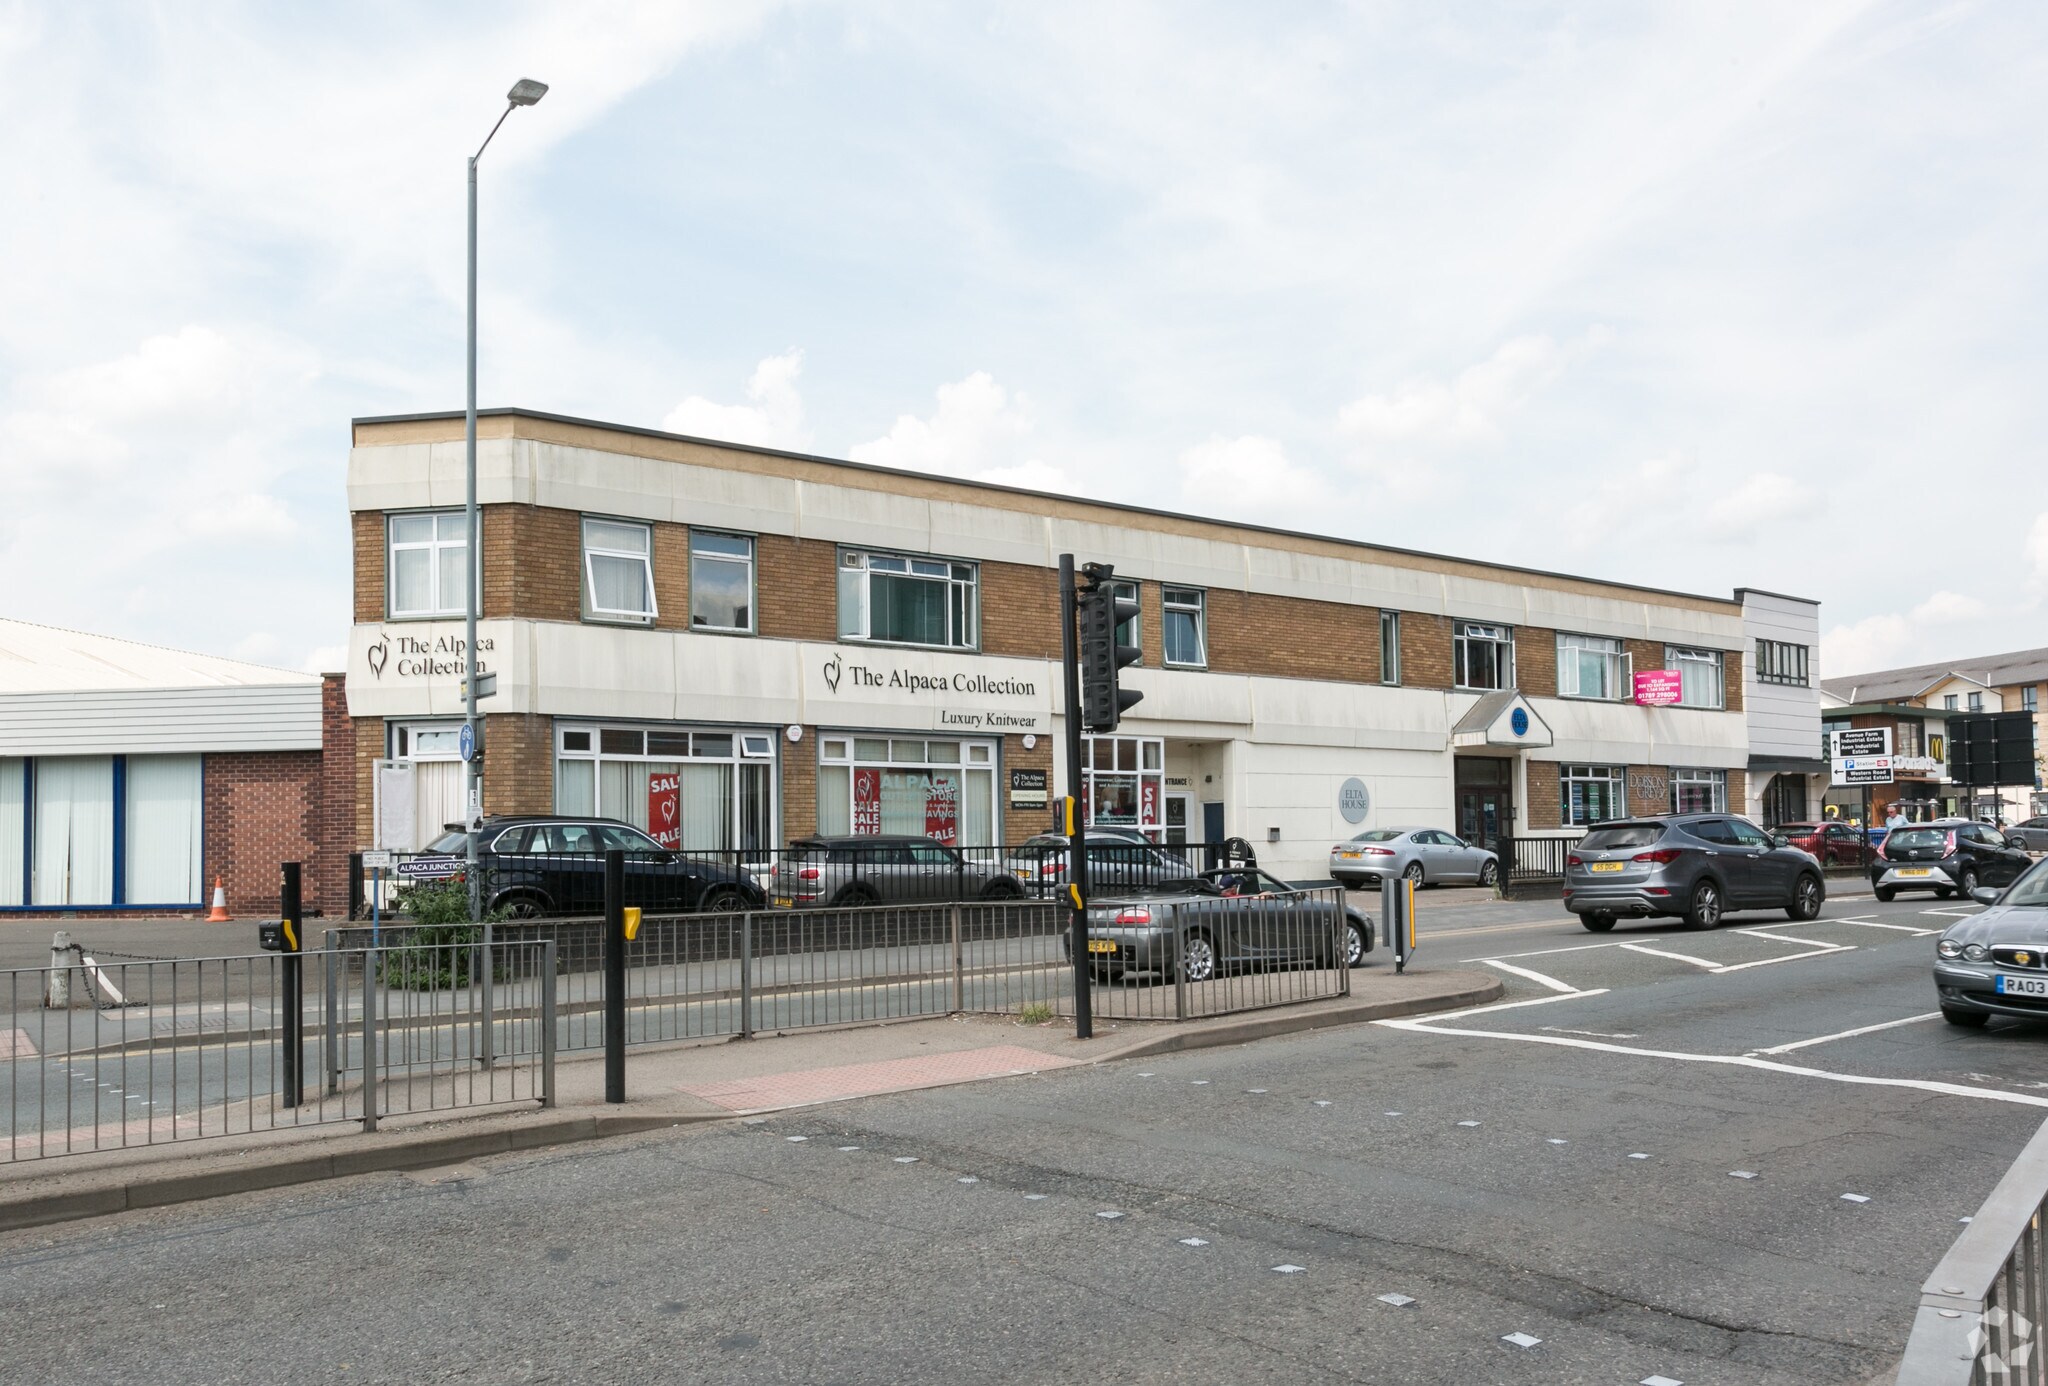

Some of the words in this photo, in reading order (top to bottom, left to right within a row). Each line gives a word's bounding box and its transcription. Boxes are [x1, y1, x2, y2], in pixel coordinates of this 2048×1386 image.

[397, 637, 429, 653] The
[434, 636, 494, 656] Alpca
[398, 657, 486, 676] Collectin
[849, 667, 883, 686] The
[889, 669, 948, 693] Alpaca
[953, 673, 1035, 695] Collection
[942, 710, 982, 728] Luxury
[986, 712, 1036, 727] Knitwear
[880, 775, 958, 790] ALPACA
[925, 792, 959, 801] STORE
[1345, 789, 1363, 799] ELTA
[1341, 800, 1367, 809] HOUSE
[854, 813, 879, 824] SALE
[2006, 979, 2046, 994] RA03
